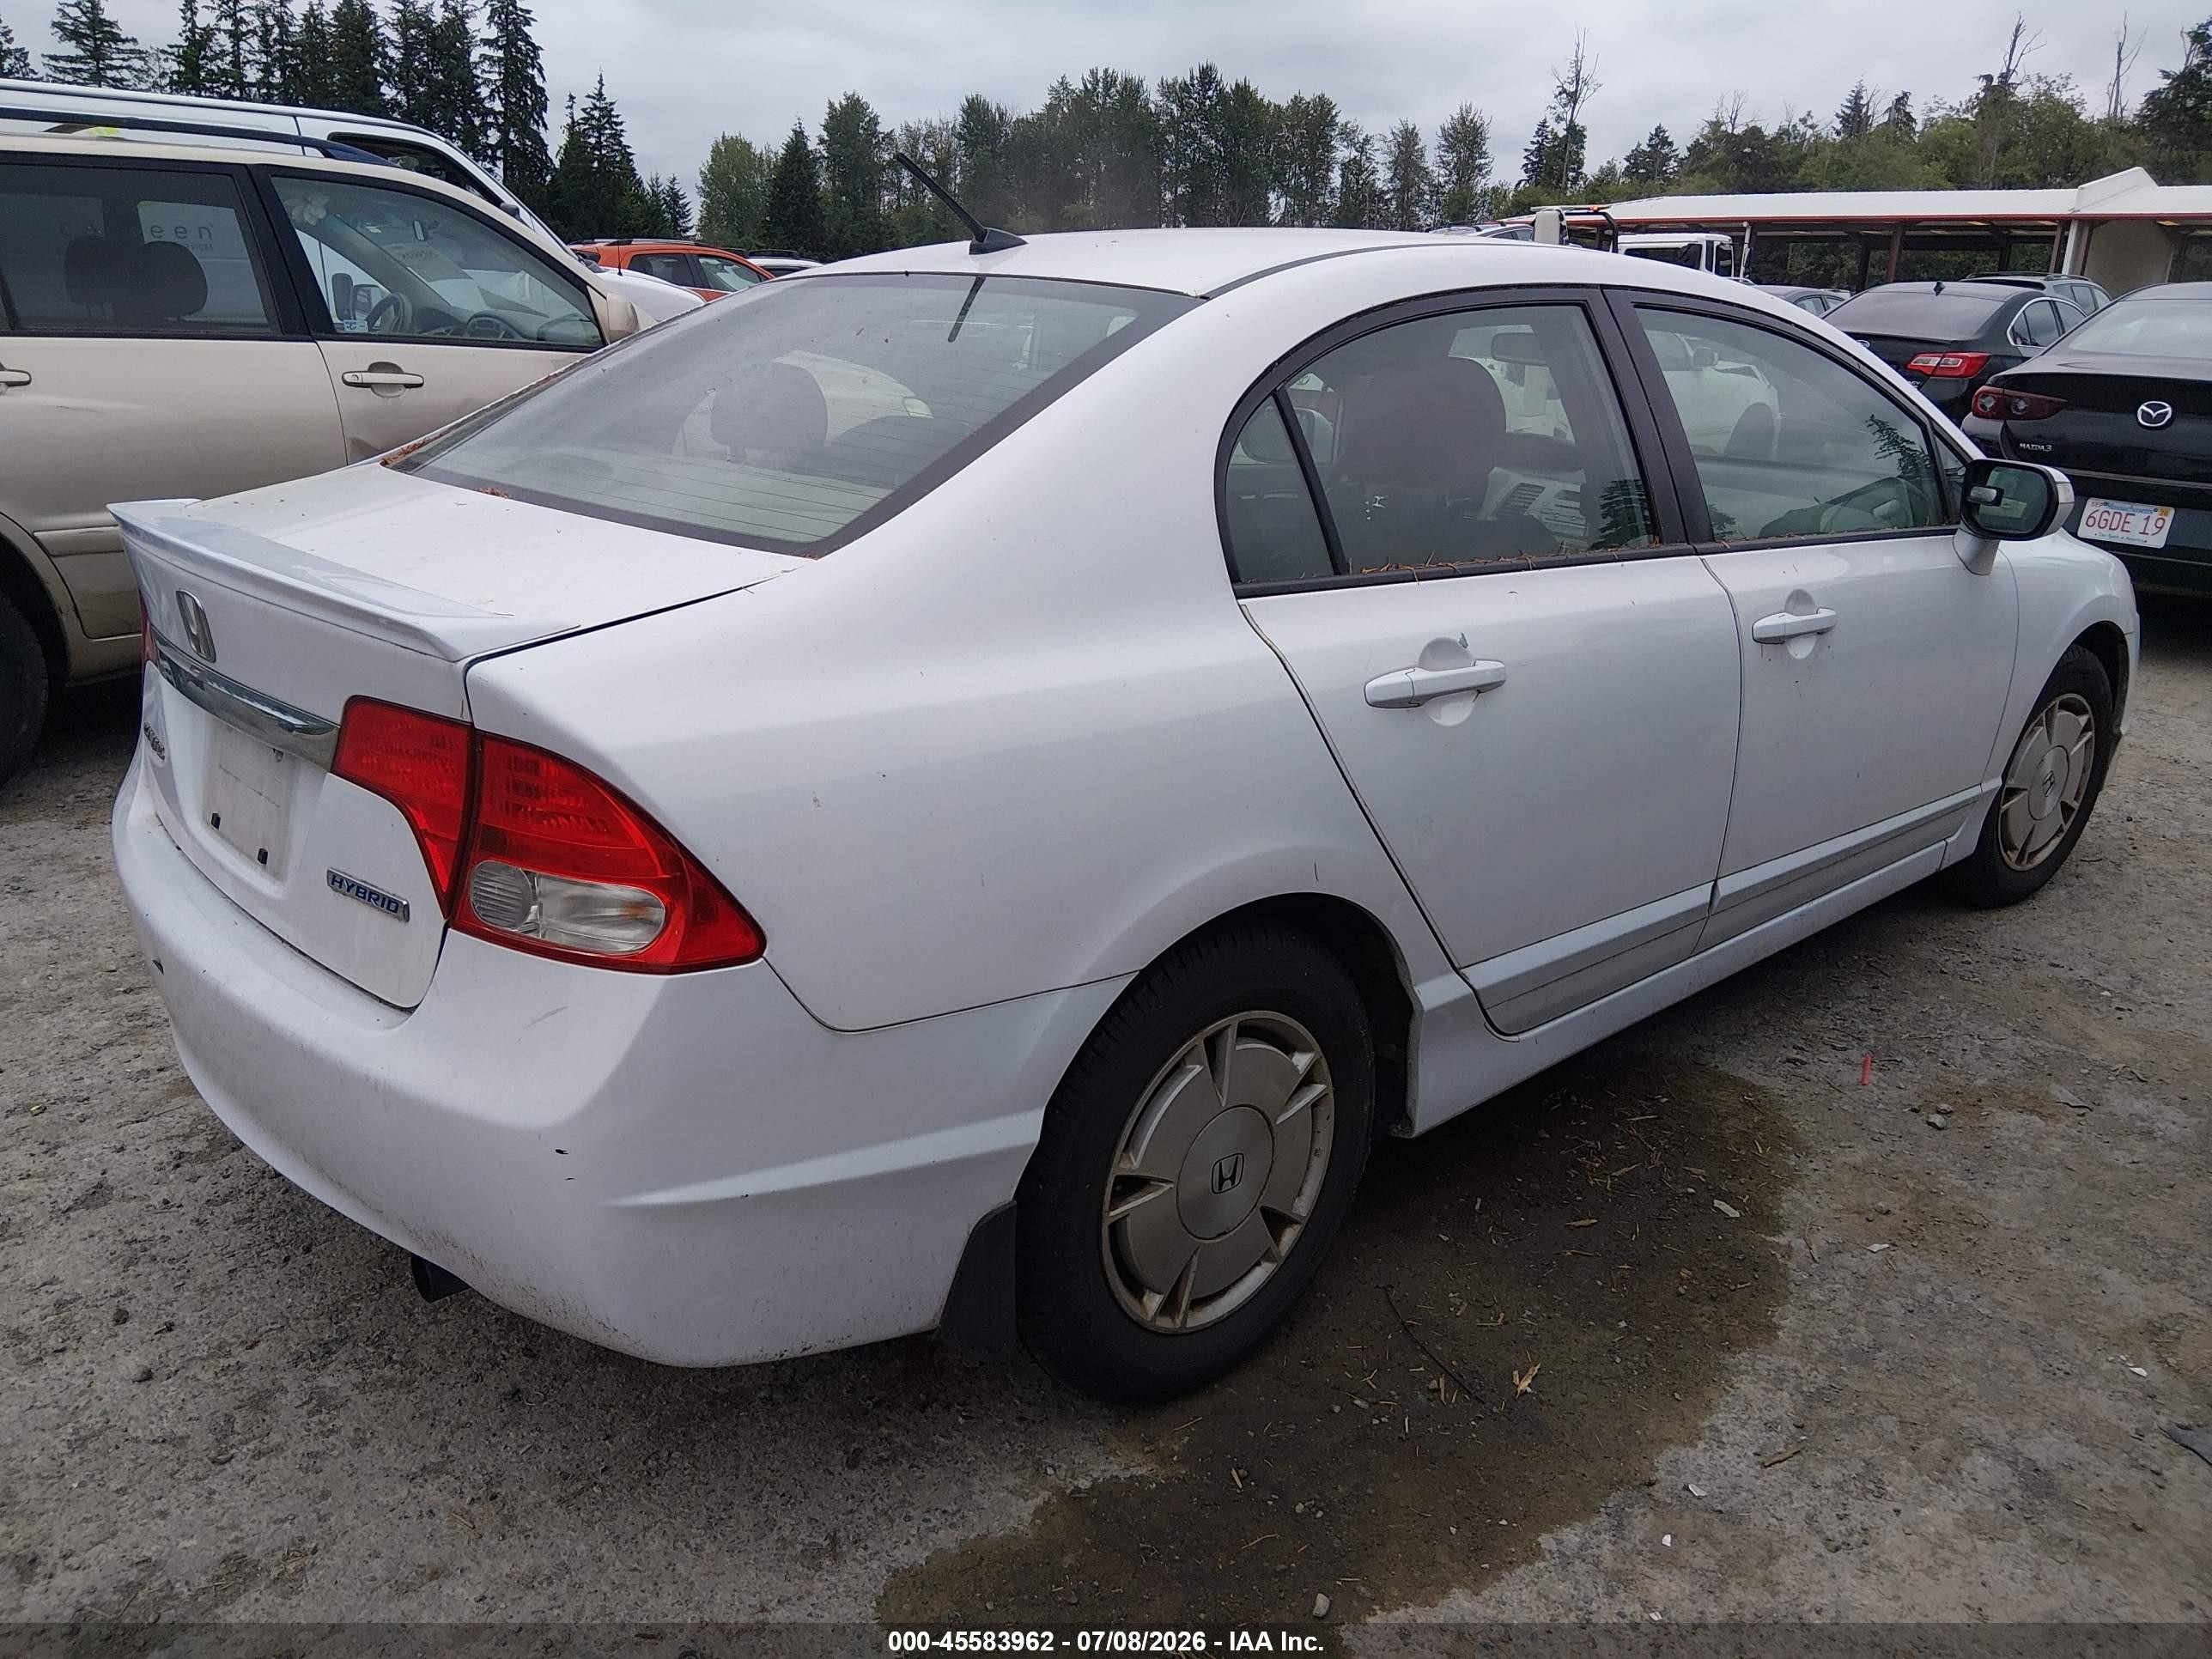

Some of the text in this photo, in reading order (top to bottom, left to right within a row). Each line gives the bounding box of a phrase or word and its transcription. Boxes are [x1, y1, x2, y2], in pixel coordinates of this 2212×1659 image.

[2085, 509, 2166, 536] 6GDE 19
[331, 874, 399, 914] HYBRID
